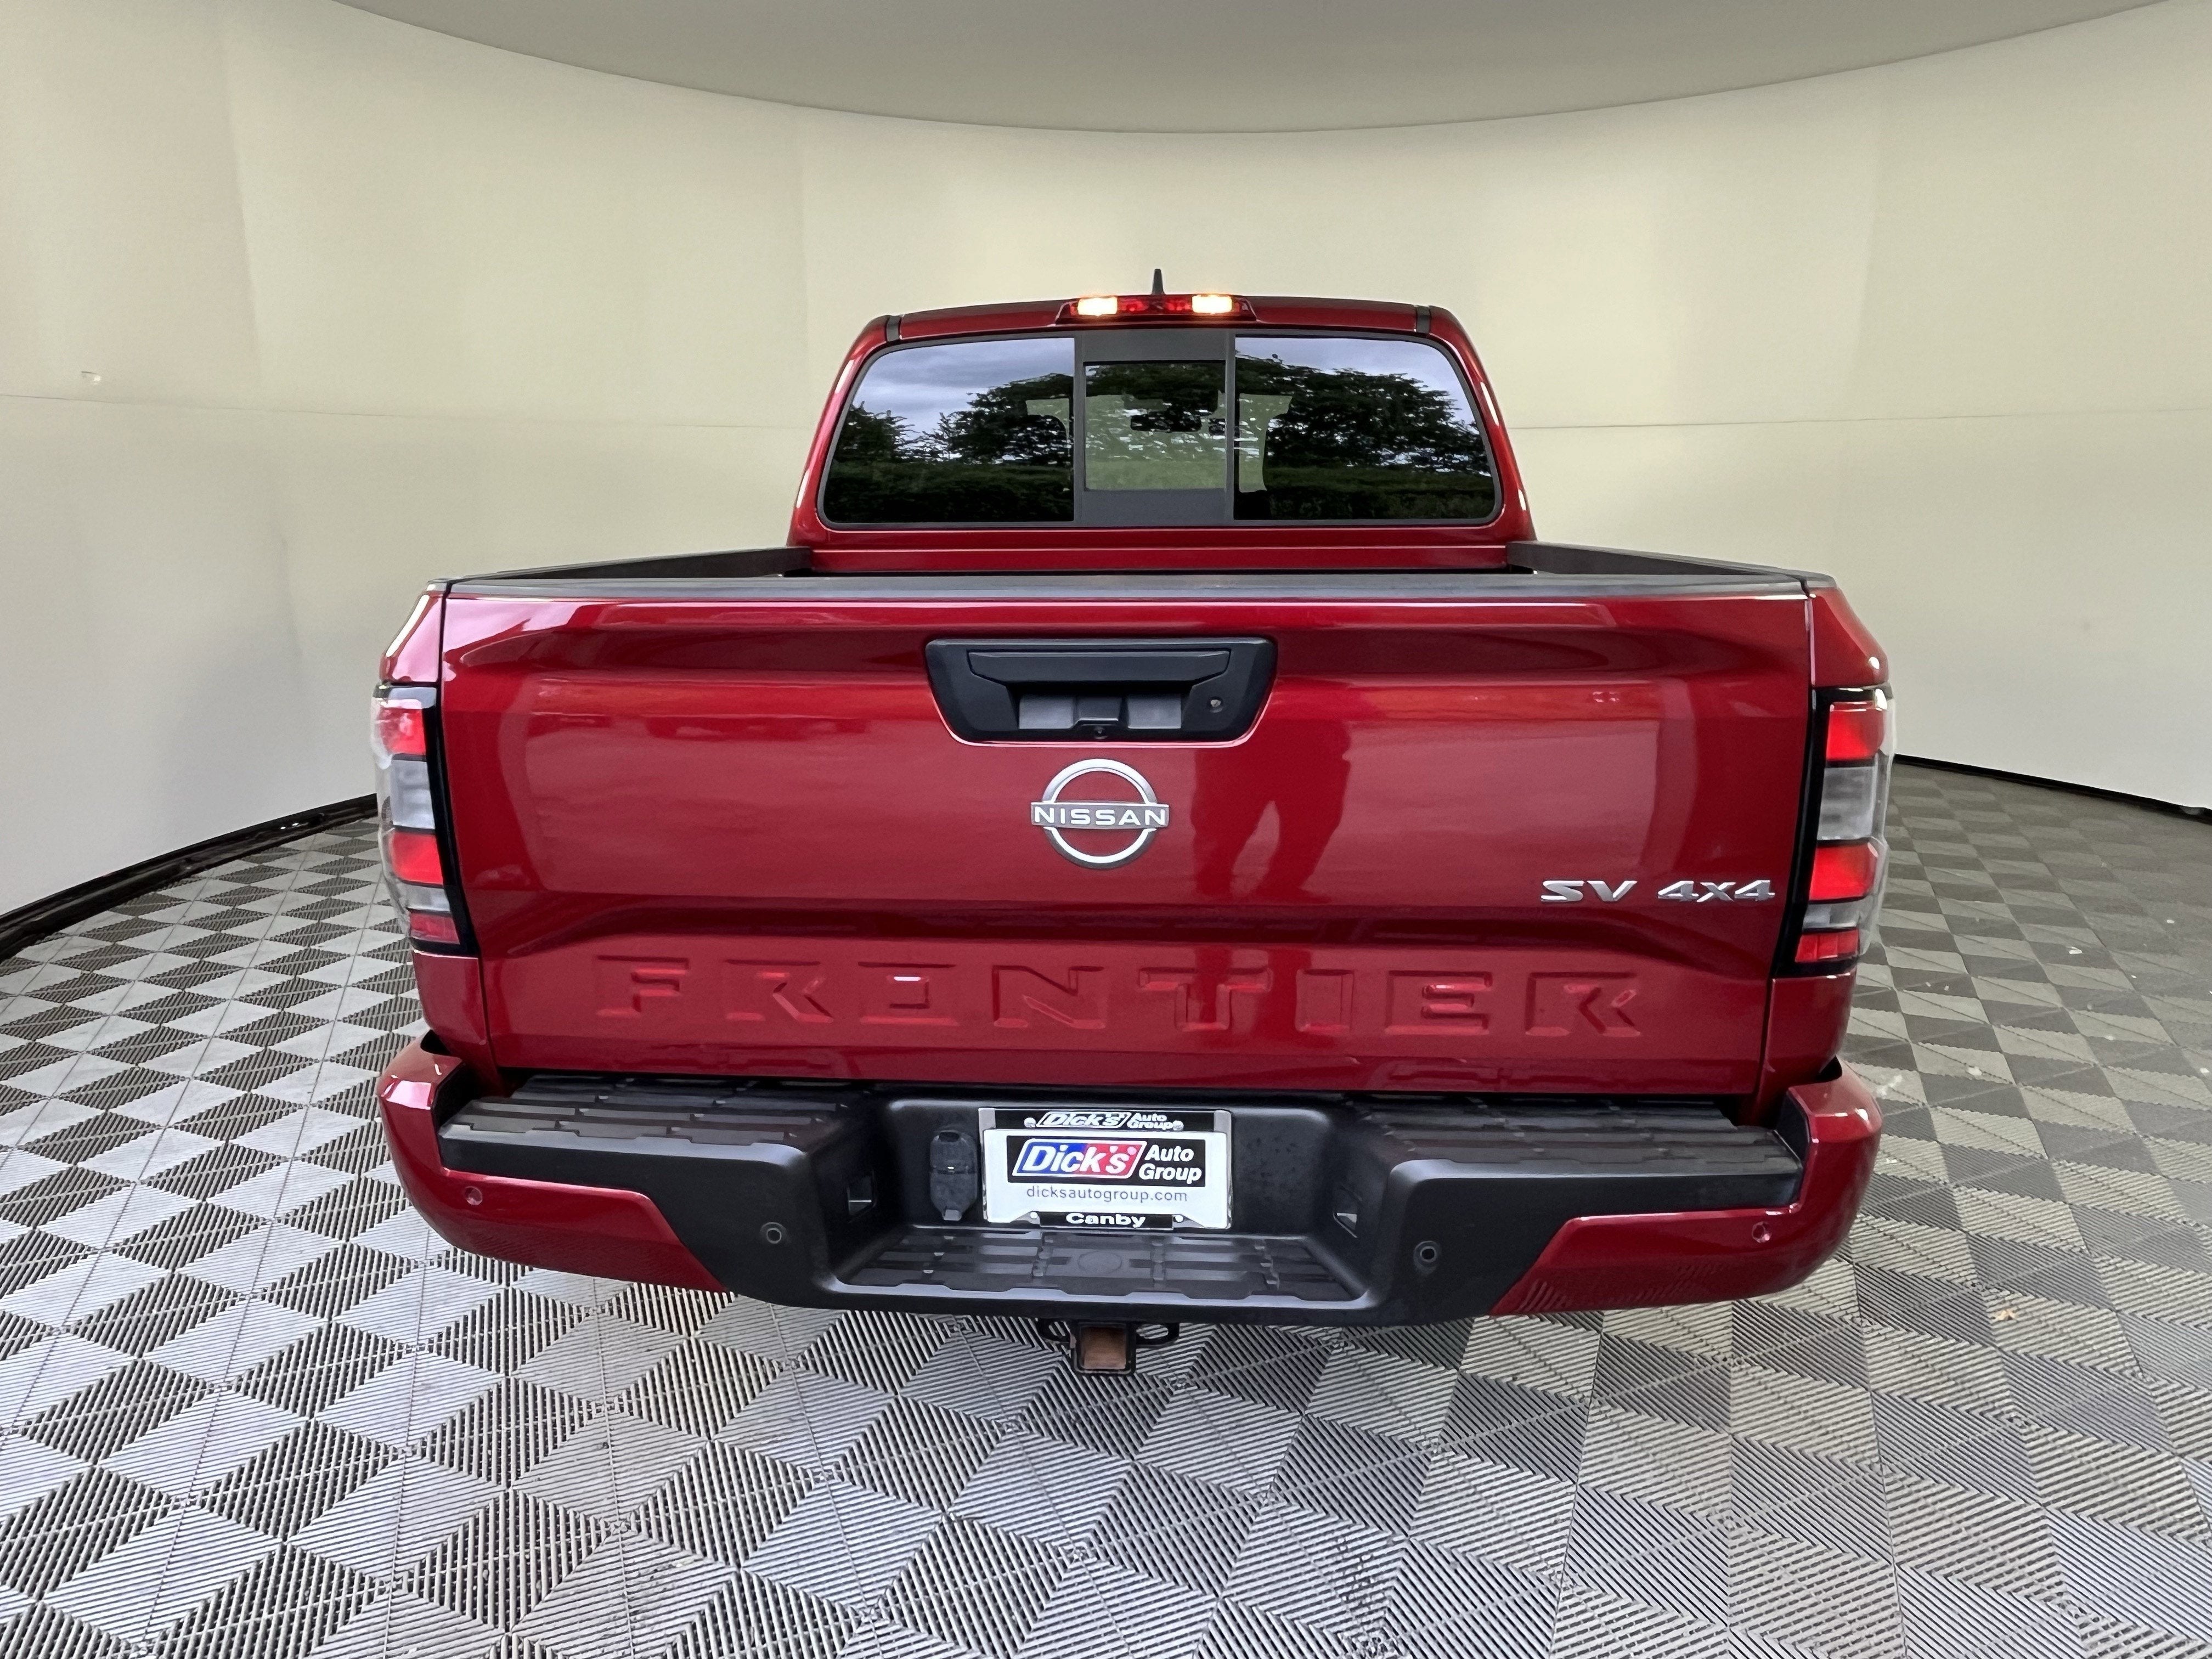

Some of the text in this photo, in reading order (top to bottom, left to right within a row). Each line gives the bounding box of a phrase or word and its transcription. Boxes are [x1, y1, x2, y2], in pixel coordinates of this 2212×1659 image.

[1034, 806, 1165, 826] NISSAN
[1541, 879, 1638, 902] SV
[596, 955, 1641, 1036] FRONTIER
[1043, 1112, 1173, 1130] Dick's Auto Group
[1022, 1144, 1202, 1184] Dick's Auto Group
[1026, 1186, 1188, 1203] dicksautogroup.com
[1065, 1212, 1146, 1228] Canby
